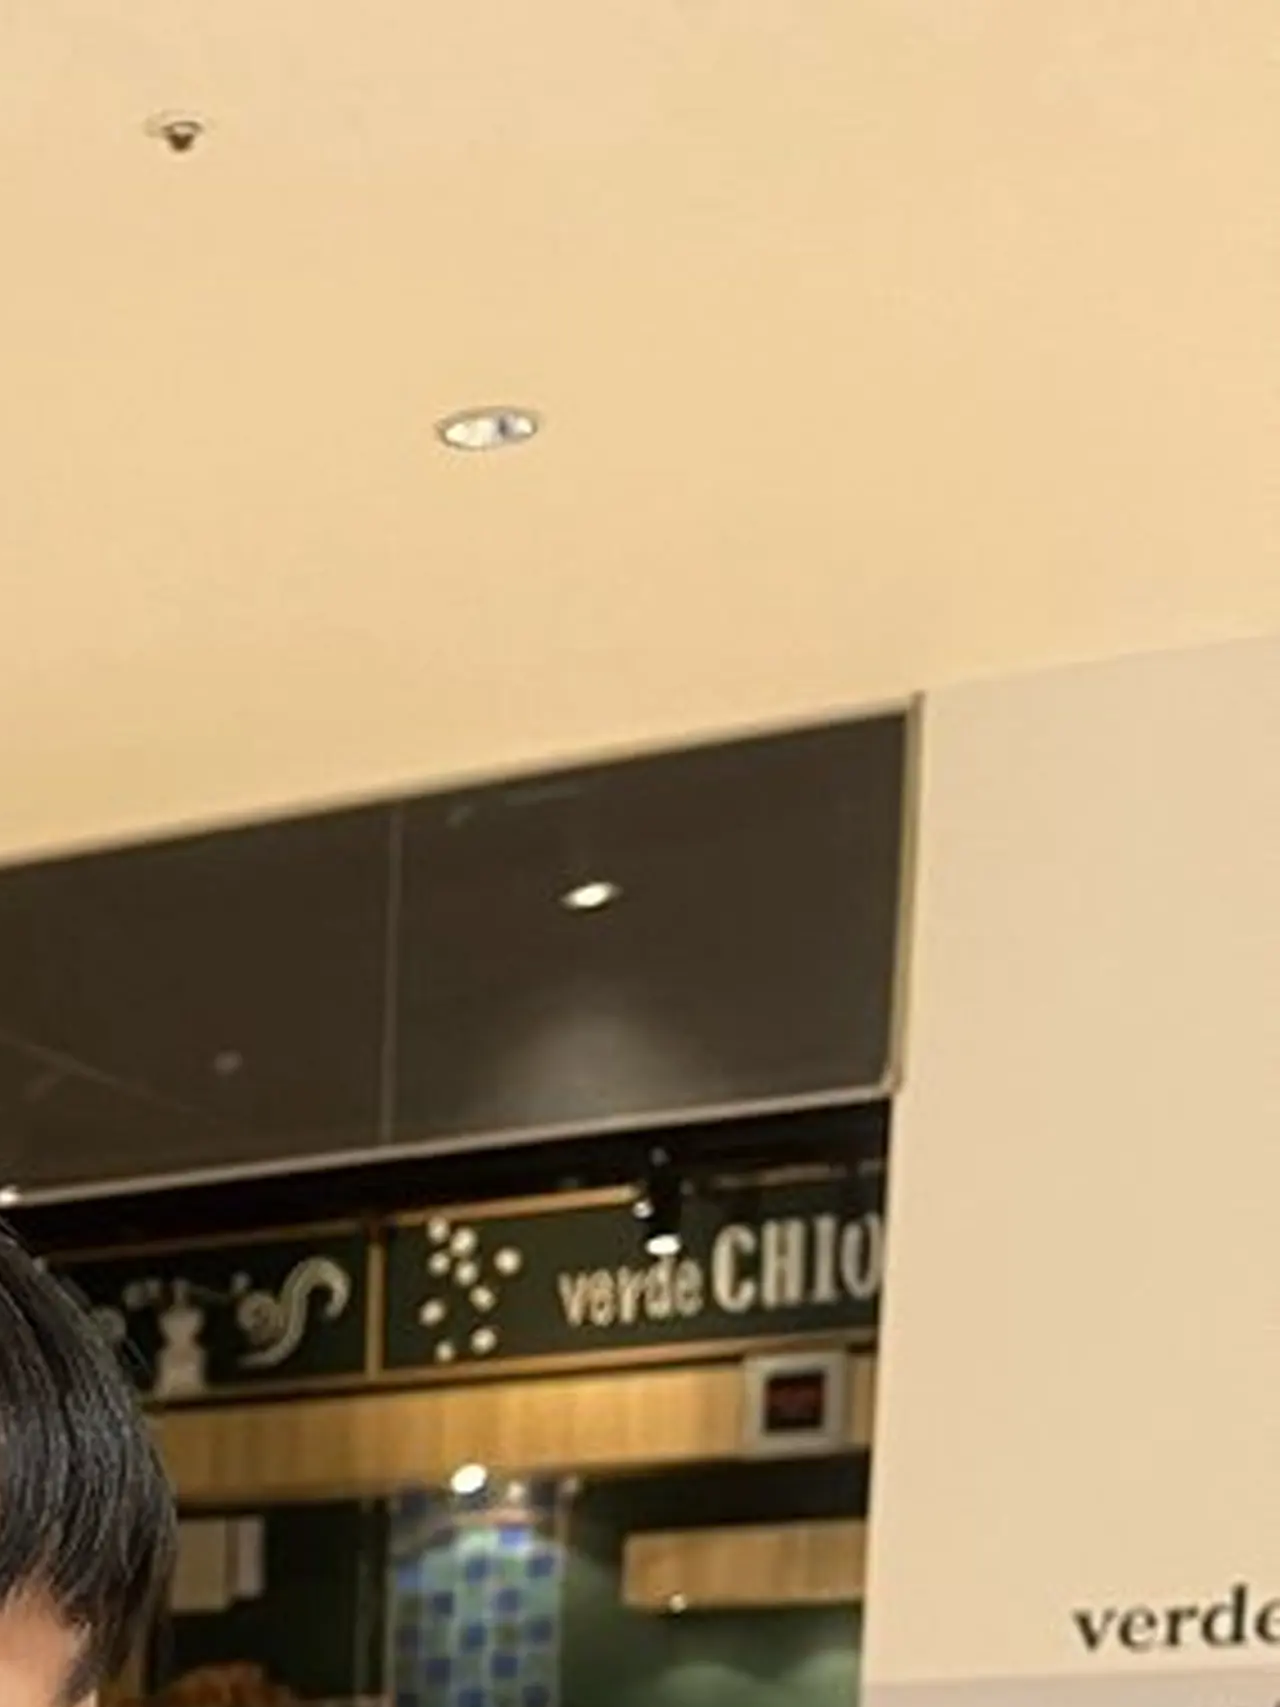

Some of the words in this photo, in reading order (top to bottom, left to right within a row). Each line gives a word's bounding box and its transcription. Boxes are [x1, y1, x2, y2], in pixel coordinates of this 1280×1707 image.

[556, 1252, 704, 1328] verde
[711, 1211, 886, 1314] CHIO
[1071, 1581, 1280, 1653] verde
